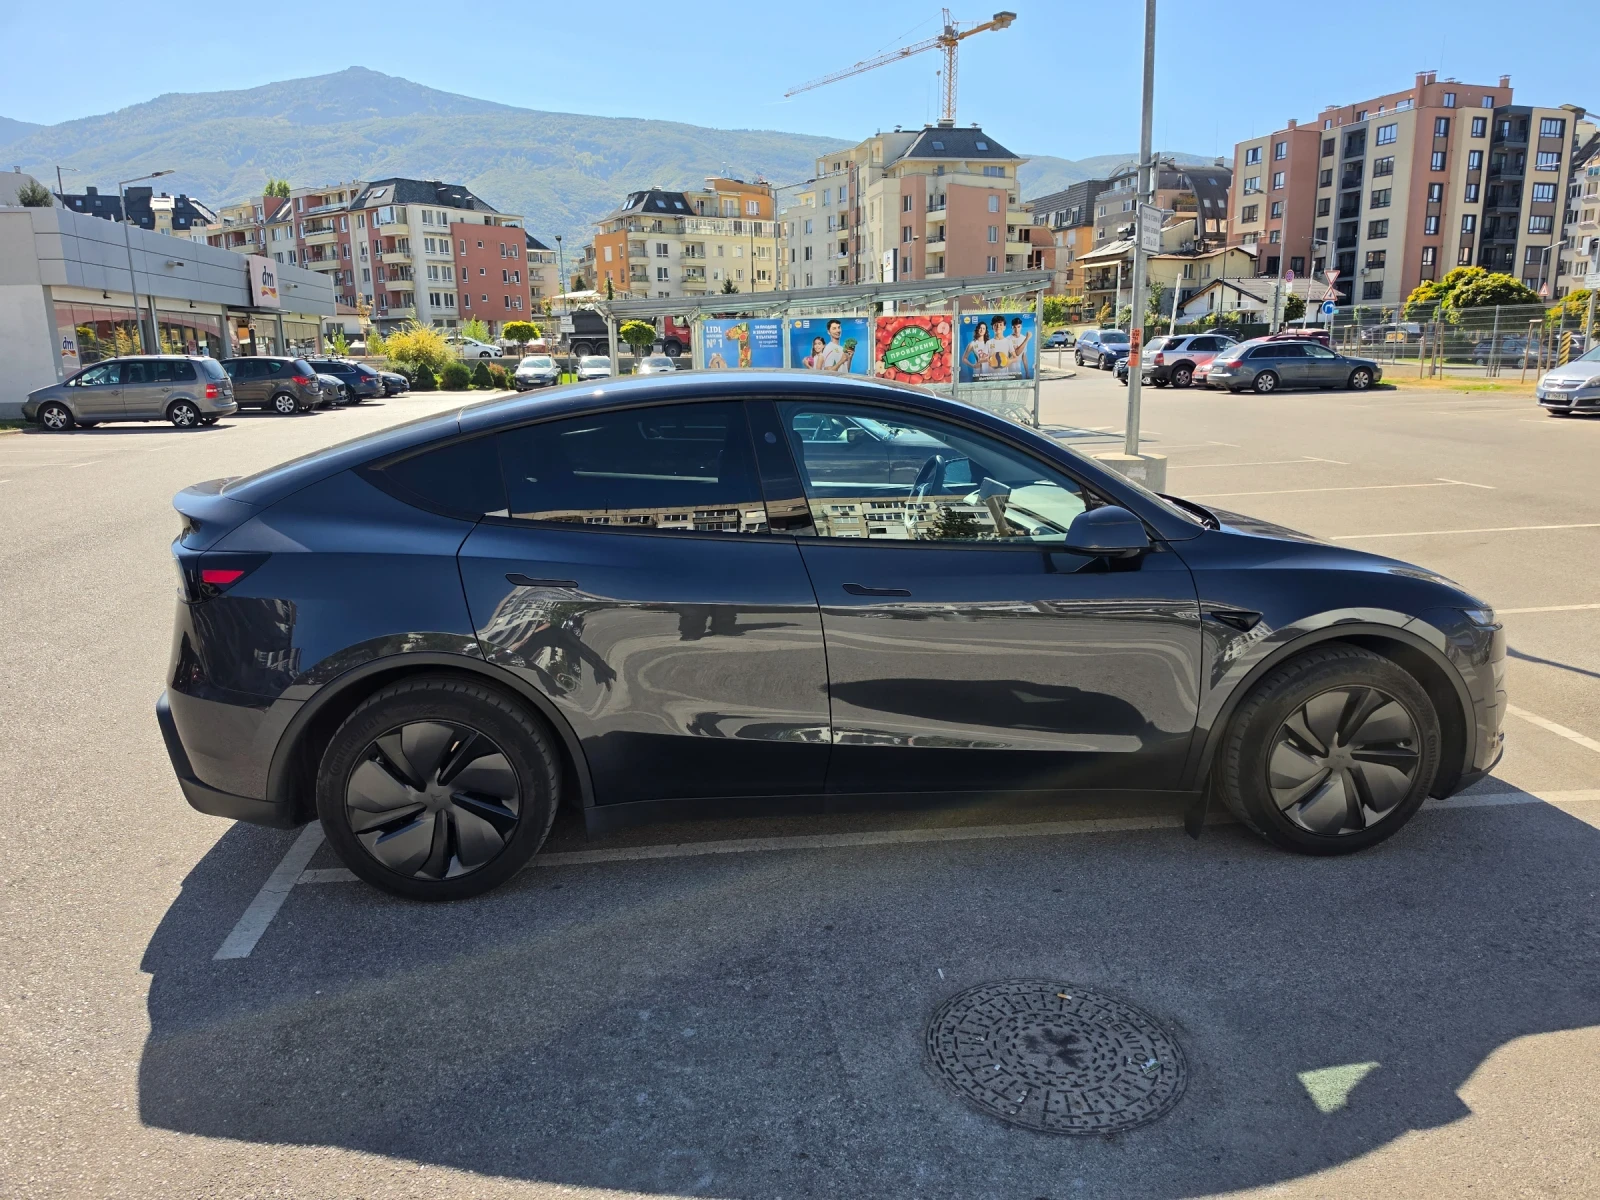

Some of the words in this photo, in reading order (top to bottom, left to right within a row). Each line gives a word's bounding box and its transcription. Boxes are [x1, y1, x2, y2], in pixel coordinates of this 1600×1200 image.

[262, 265, 274, 287] dm
[62, 336, 74, 349] dm
[718, 339, 723, 348] 1
[893, 328, 917, 345] СВЕЖИ
[890, 341, 934, 359] ПРОВЕРЕНИ
[1099, 1016, 1148, 1062] BENITO
